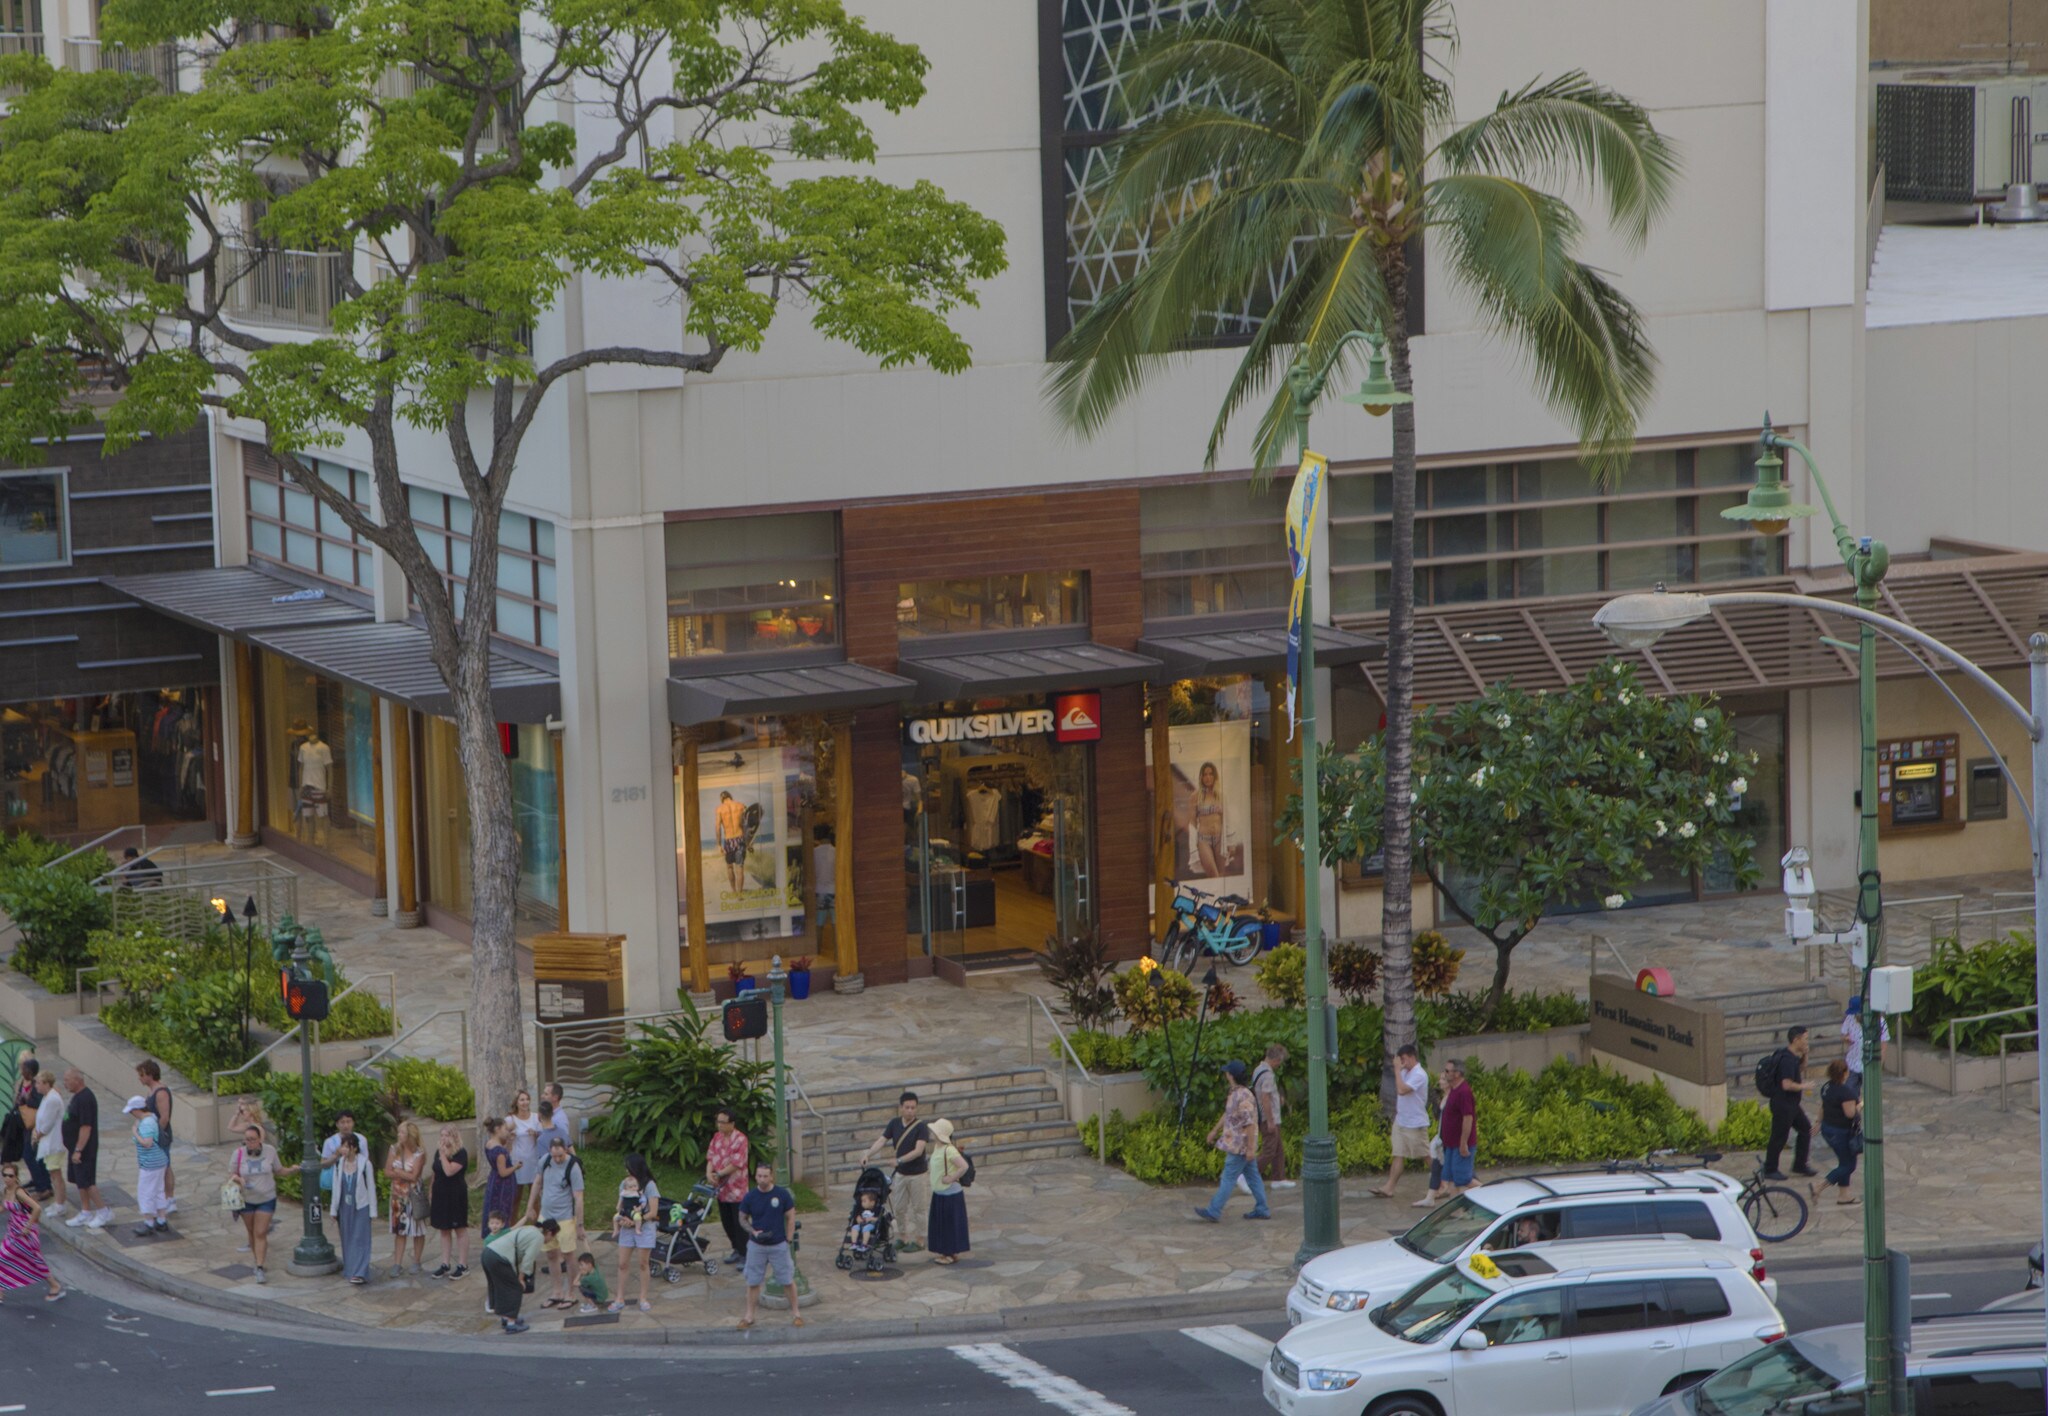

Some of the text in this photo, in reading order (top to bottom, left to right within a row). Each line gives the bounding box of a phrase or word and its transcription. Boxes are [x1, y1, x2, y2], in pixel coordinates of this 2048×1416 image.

[910, 709, 1055, 744] QUIKSILVER
[1595, 1000, 1617, 1021] First
[1619, 1008, 1665, 1037] Hawaiian
[1667, 1024, 1694, 1047] Bank
